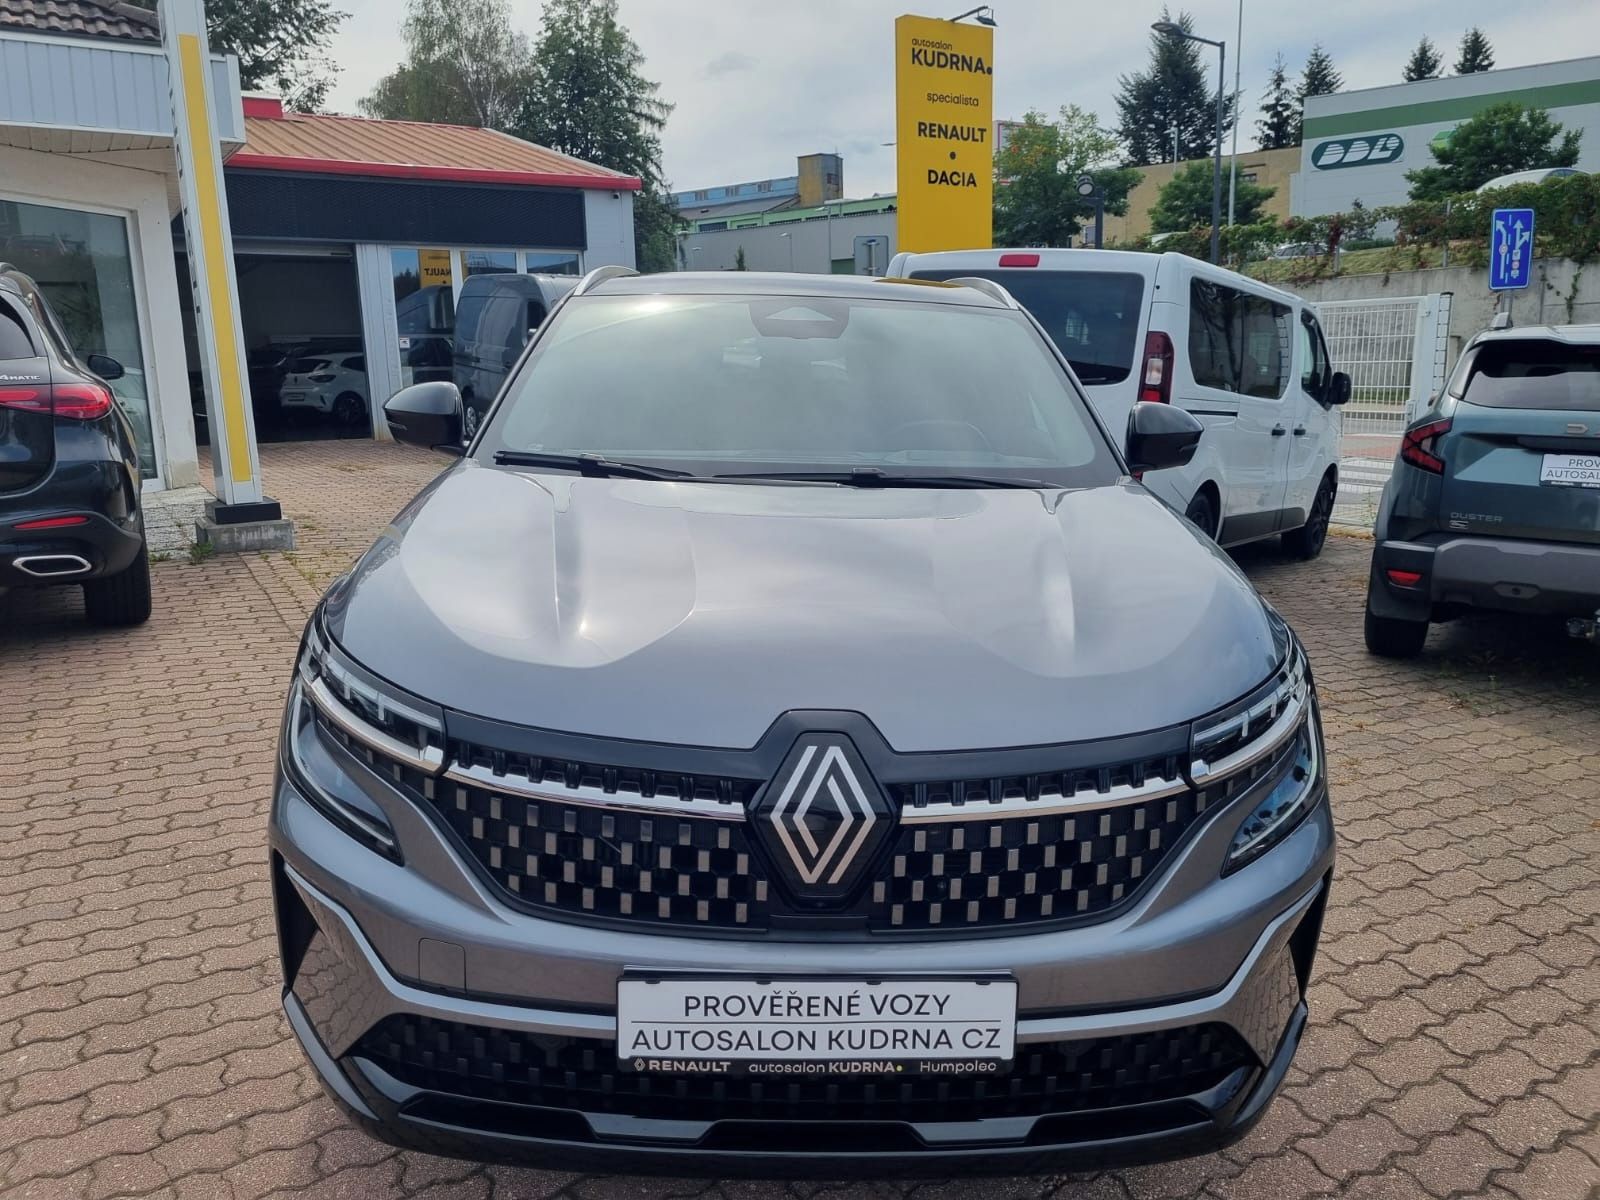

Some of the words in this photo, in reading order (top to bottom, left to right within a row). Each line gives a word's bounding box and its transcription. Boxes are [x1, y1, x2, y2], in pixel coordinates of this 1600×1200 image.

[912, 38, 952, 50] autosalon
[927, 91, 979, 107] specialista
[918, 121, 987, 142] RENAULT
[927, 169, 977, 187] DACIA
[1450, 512, 1504, 522] DUSTER
[684, 990, 861, 1017] PROVĚŘENÉ
[869, 994, 951, 1016] VOZY
[631, 1029, 817, 1051] AUTOSALON
[828, 1029, 953, 1050] KUDRNA
[962, 1028, 1001, 1049] CZ
[648, 1060, 731, 1072] RENAULT
[749, 1061, 825, 1073] autosalon
[920, 1060, 997, 1074] Humpolec
